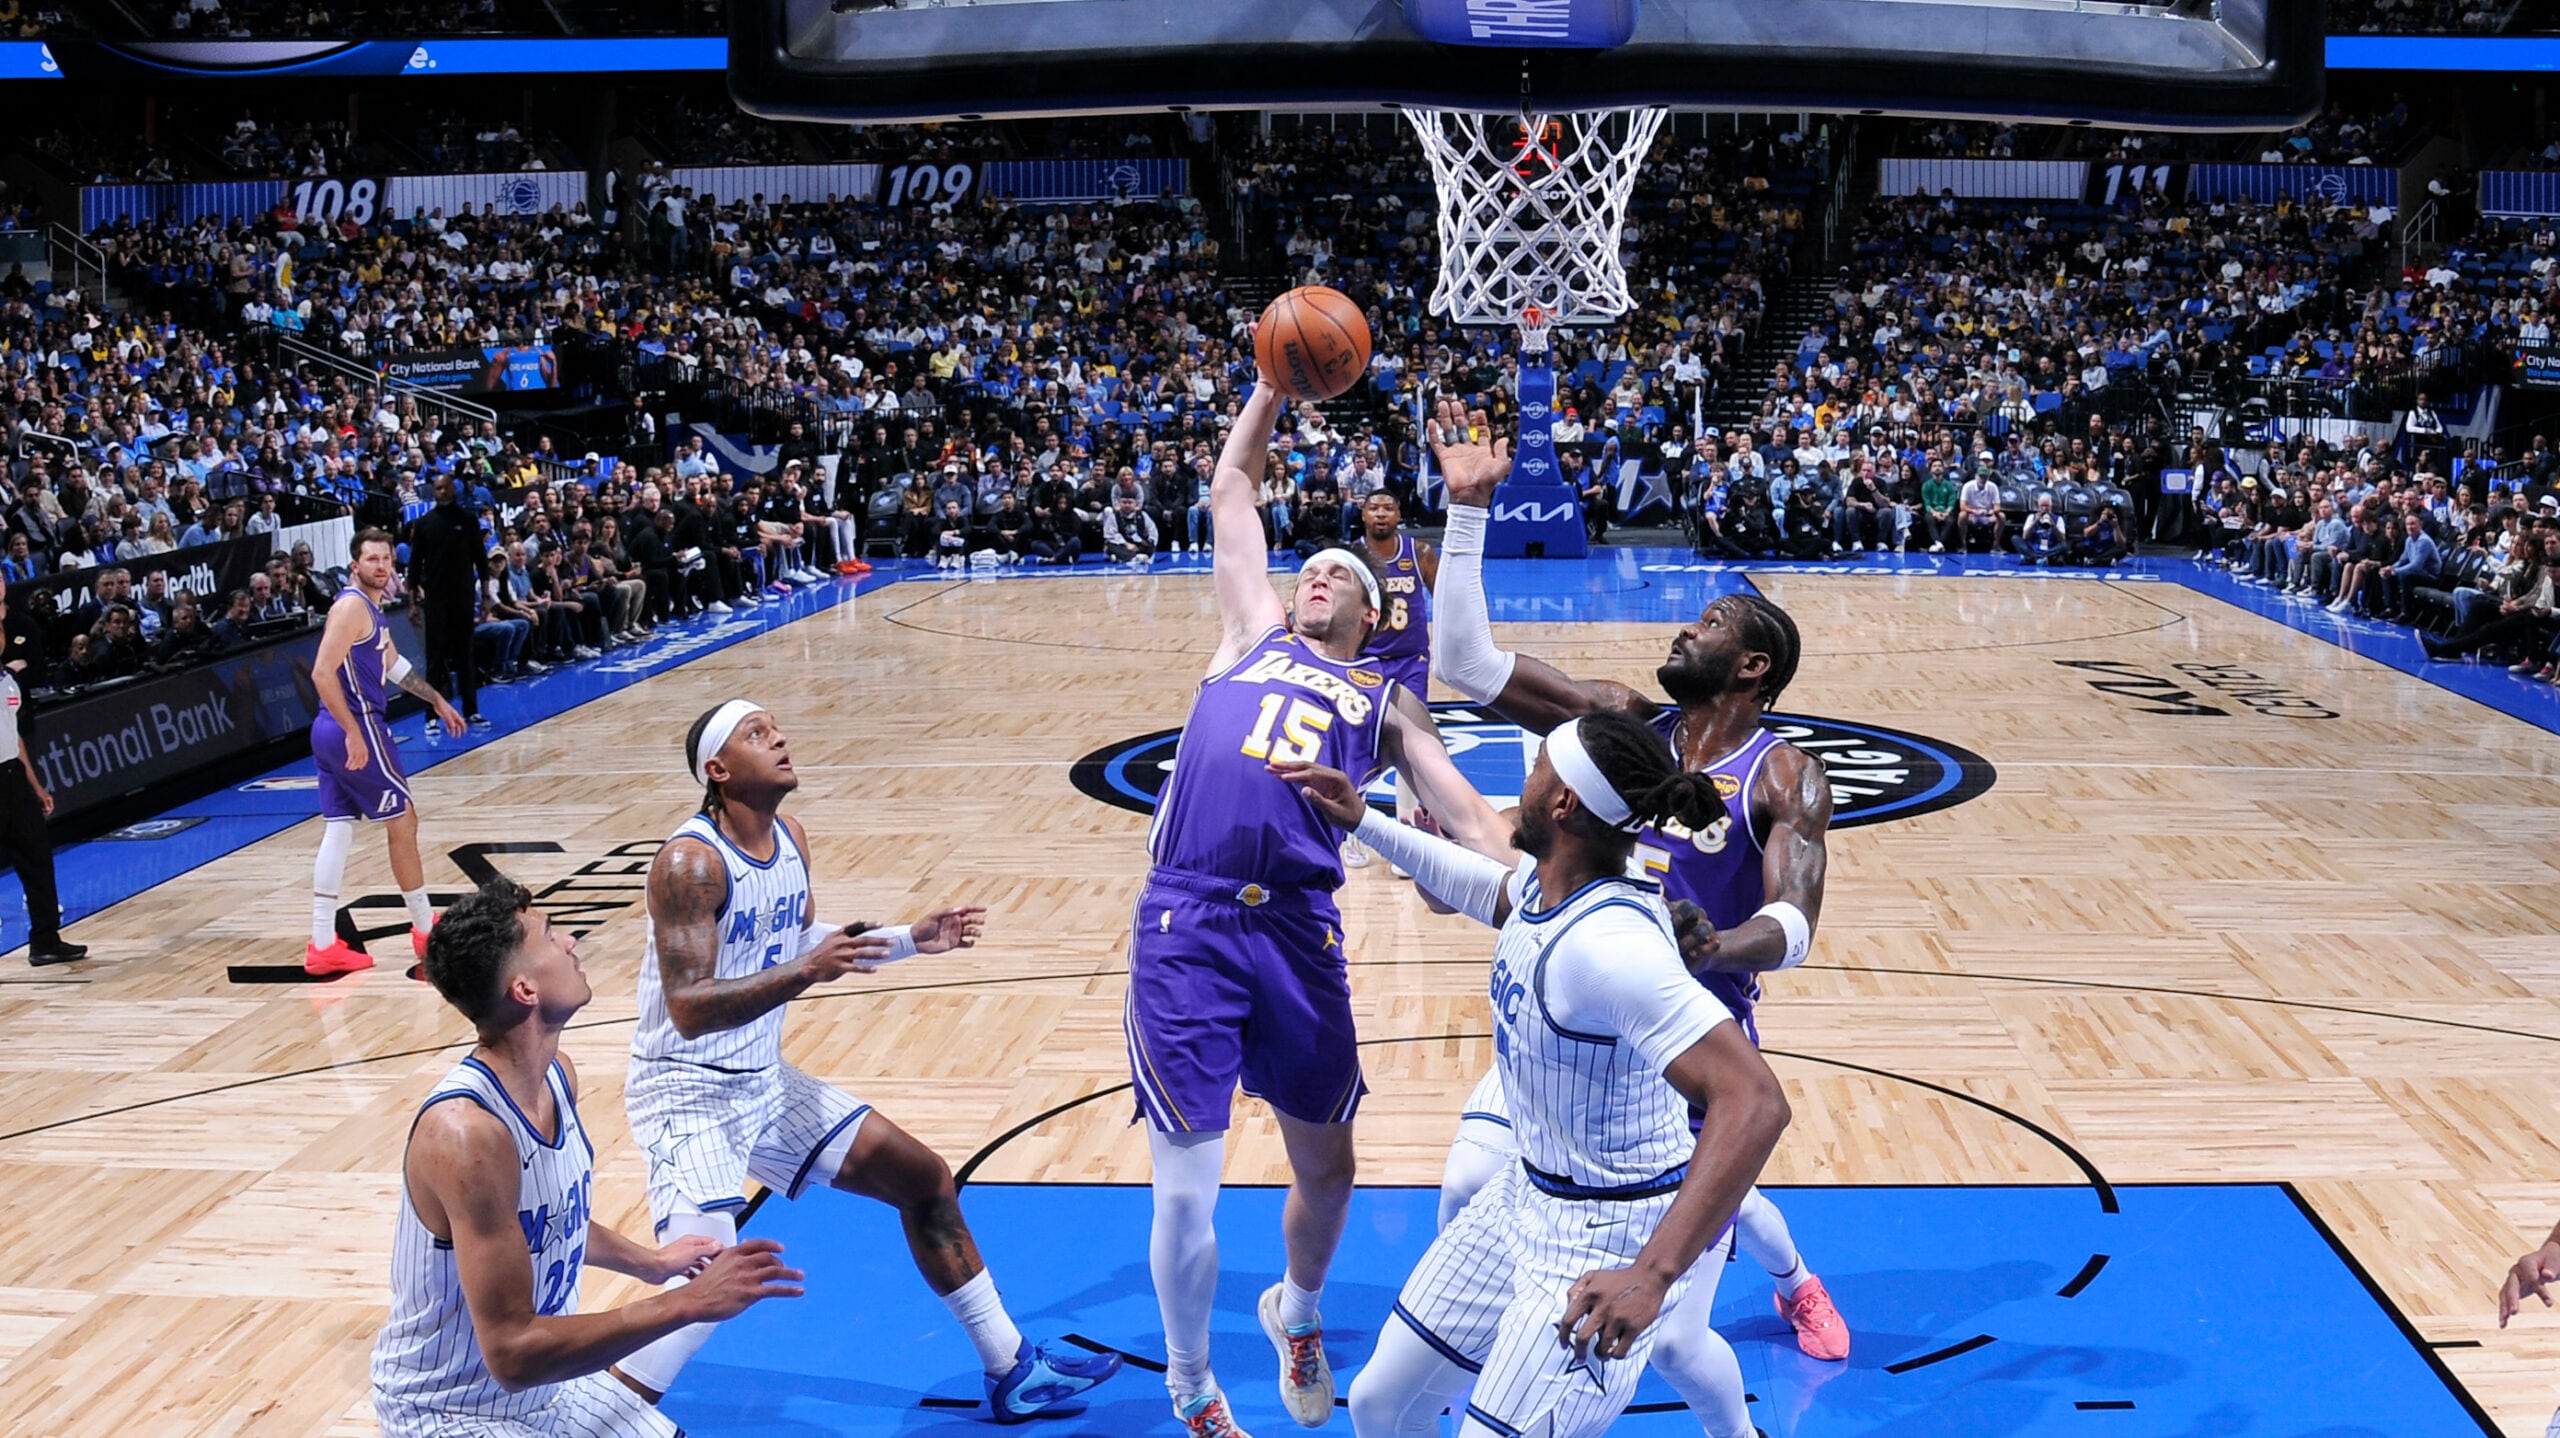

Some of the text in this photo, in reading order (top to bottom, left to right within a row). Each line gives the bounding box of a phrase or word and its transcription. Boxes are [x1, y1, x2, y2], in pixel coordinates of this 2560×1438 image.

[294, 178, 377, 225] 108
[888, 163, 973, 206] 109
[2103, 164, 2171, 205] 111
[389, 358, 481, 377] City National Bank
[520, 373, 529, 388] 6
[1494, 502, 1574, 522] KIA
[1229, 650, 1373, 726] LAKERS
[2171, 663, 2341, 719] CENTER
[37, 690, 235, 793] ational Bank
[1240, 692, 1334, 764] 15
[535, 1242, 584, 1316] 23
